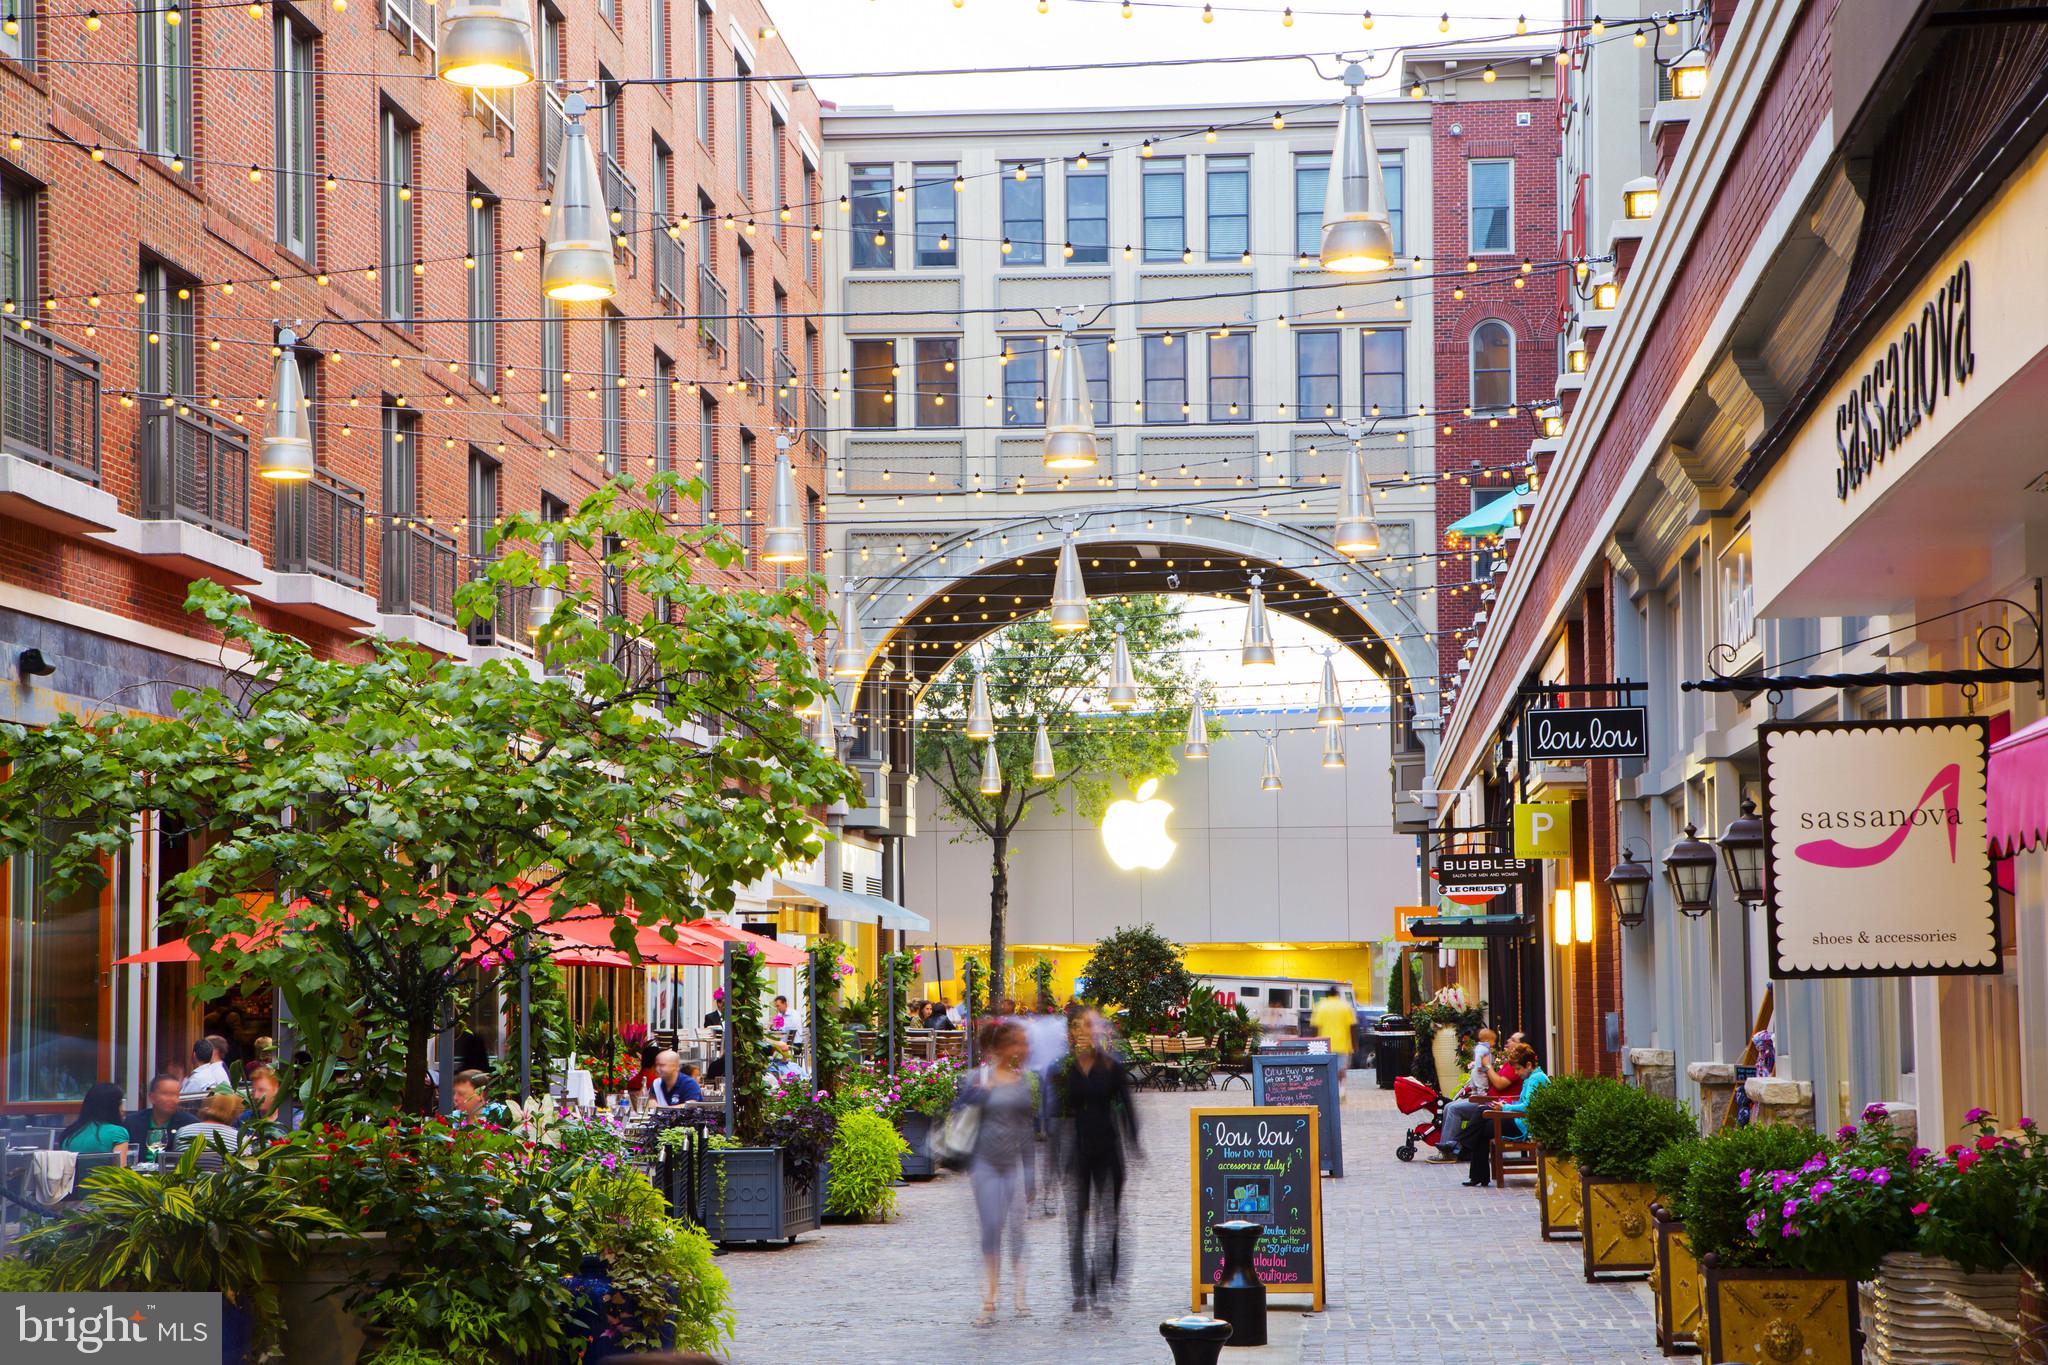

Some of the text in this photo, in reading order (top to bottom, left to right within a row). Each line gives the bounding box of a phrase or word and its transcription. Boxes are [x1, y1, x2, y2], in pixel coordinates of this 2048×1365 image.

[1836, 260, 1974, 499] sassanova
[1537, 718, 1638, 750] lou lou
[1801, 807, 1963, 830] sassanova
[1532, 812, 1553, 846] P
[1443, 859, 1526, 871] BUBBLES
[1462, 885, 1504, 893] CREUSET
[1812, 929, 1957, 945] shoes & accessories
[1215, 1121, 1294, 1147] lou lou
[1217, 1162, 1261, 1170] accessorize
[1289, 1226, 1306, 1235] looks
[1280, 1236, 1300, 1244] Twitter
